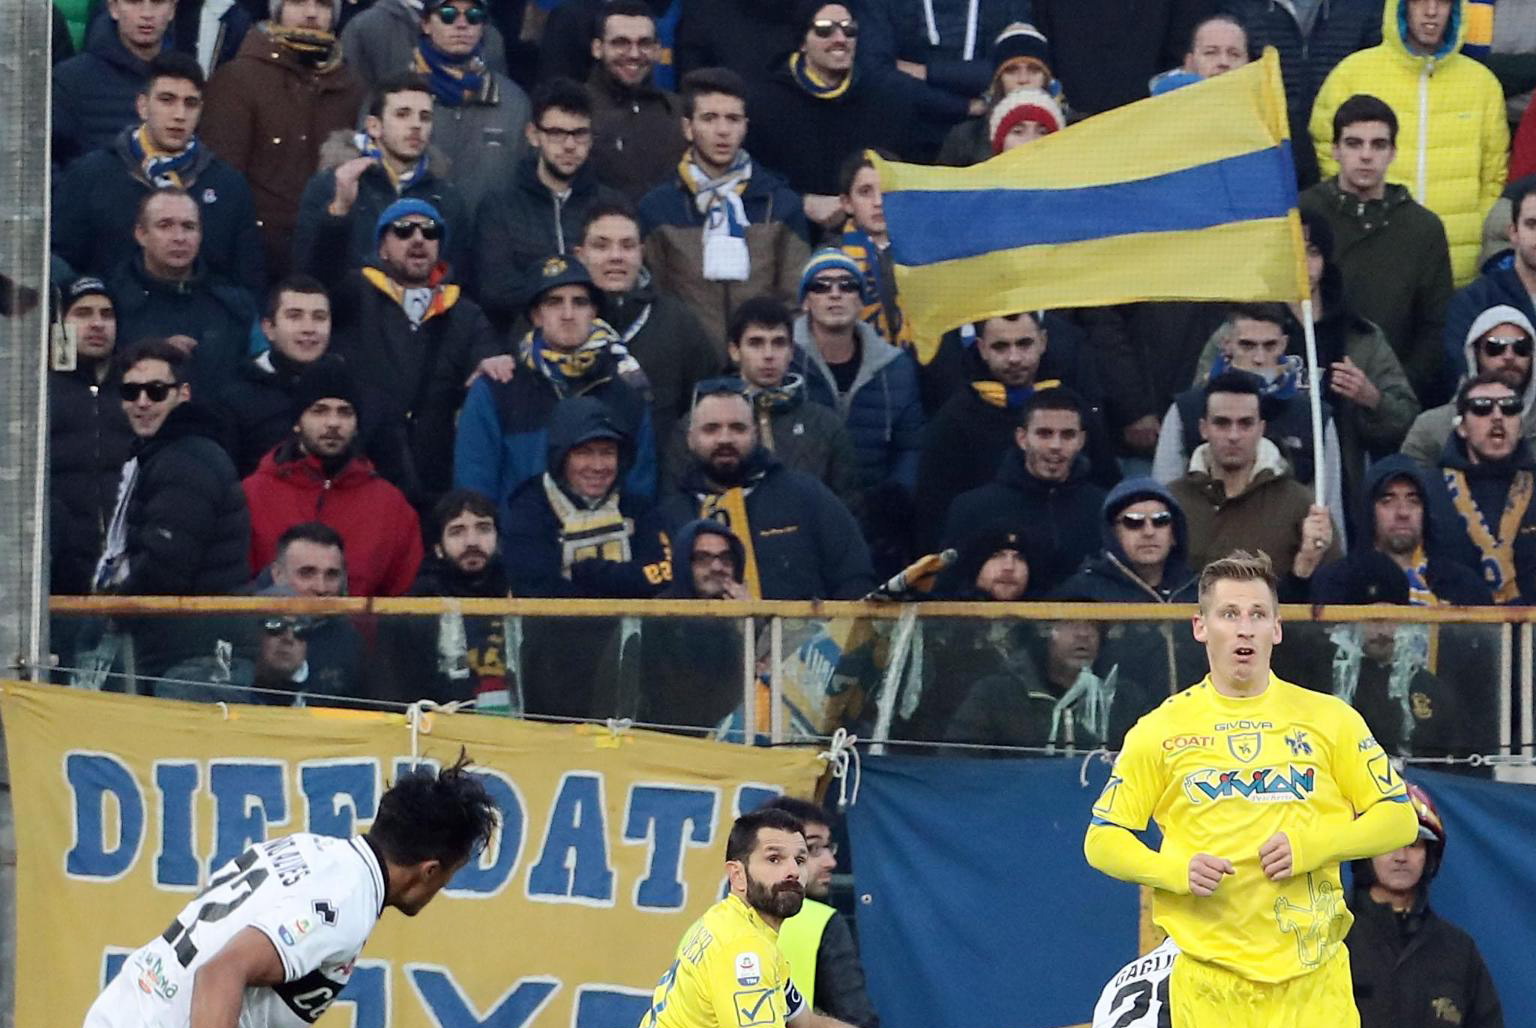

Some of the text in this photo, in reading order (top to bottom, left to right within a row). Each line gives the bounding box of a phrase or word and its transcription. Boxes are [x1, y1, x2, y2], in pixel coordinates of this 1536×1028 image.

[1214, 721, 1273, 731] GIVOVA
[1162, 736, 1215, 751] COATI
[64, 748, 787, 913] DIFFDAT
[1114, 951, 1177, 989] GAGLI
